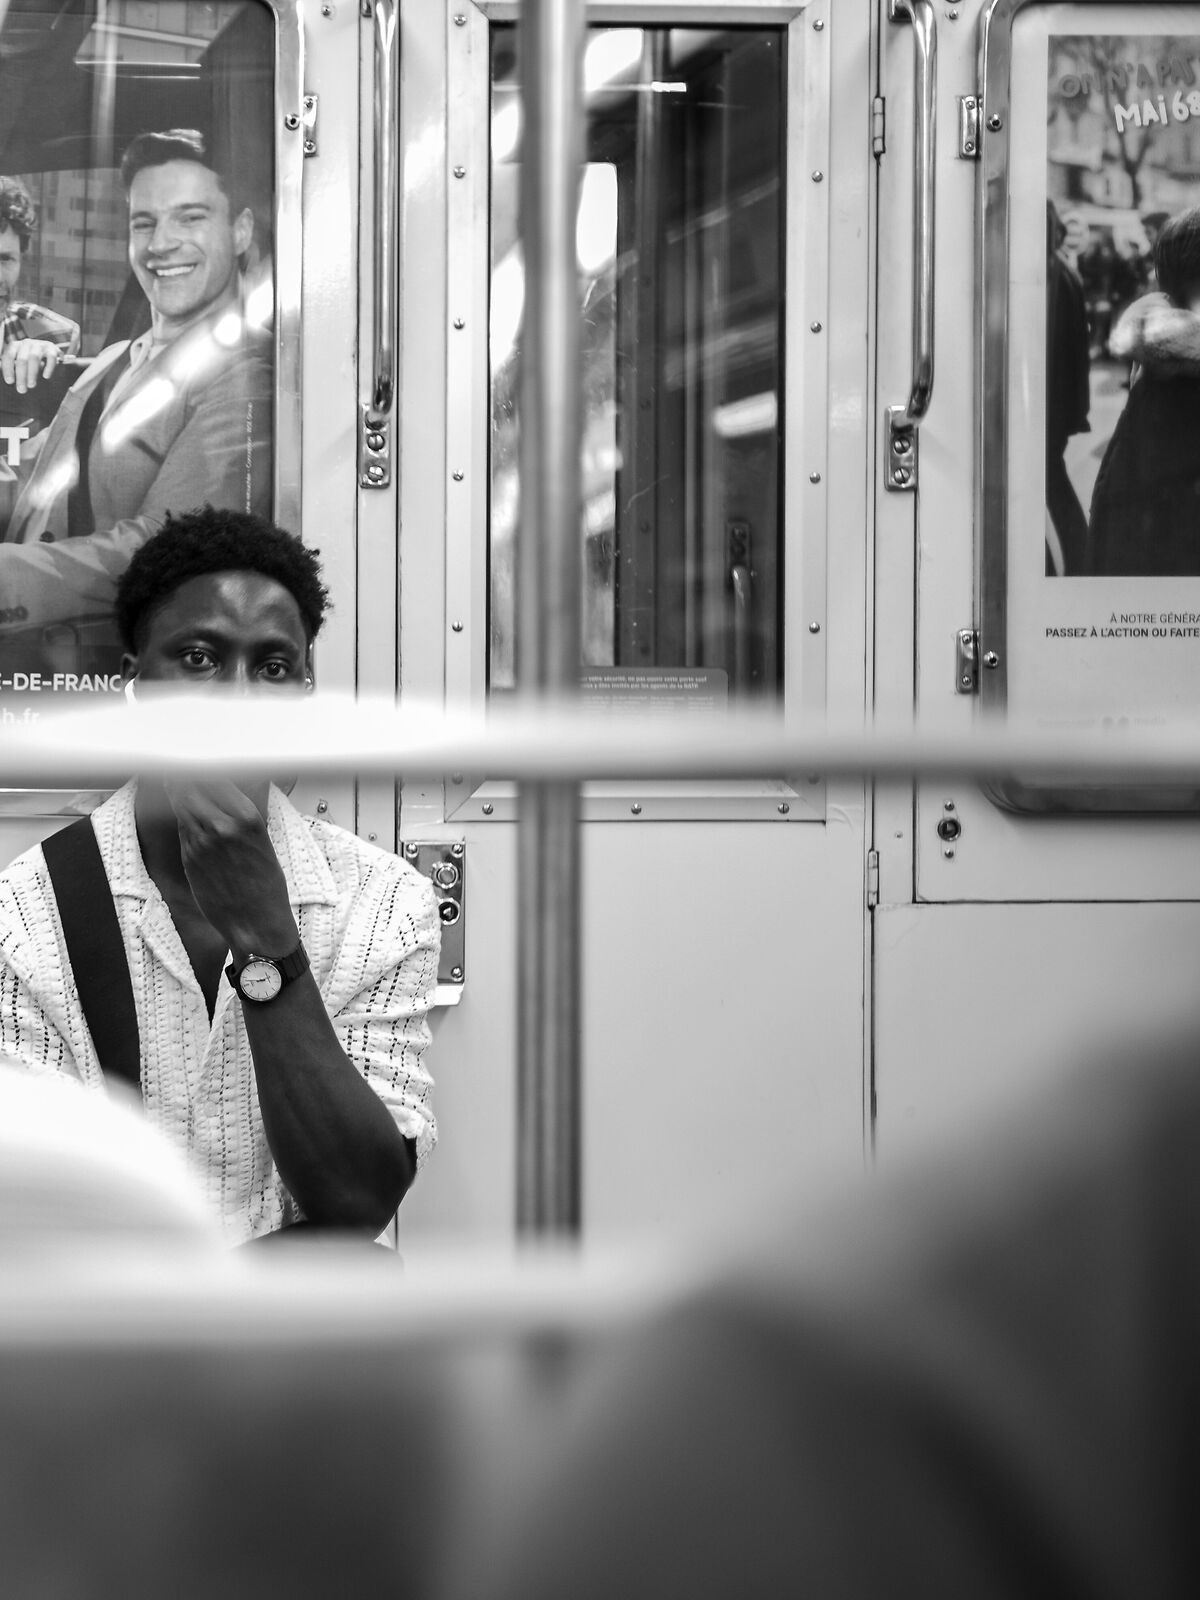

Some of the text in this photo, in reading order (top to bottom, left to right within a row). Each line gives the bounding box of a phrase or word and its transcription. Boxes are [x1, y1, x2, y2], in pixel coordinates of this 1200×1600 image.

[1171, 90, 1200, 121] 68
[1110, 611, 1118, 624] À
[1120, 613, 1157, 624] NOTRE
[1045, 628, 1087, 638] PASSEZ
[1090, 625, 1098, 638] À
[1100, 627, 1149, 638] L'ACTION
[1151, 628, 1167, 638] OU
